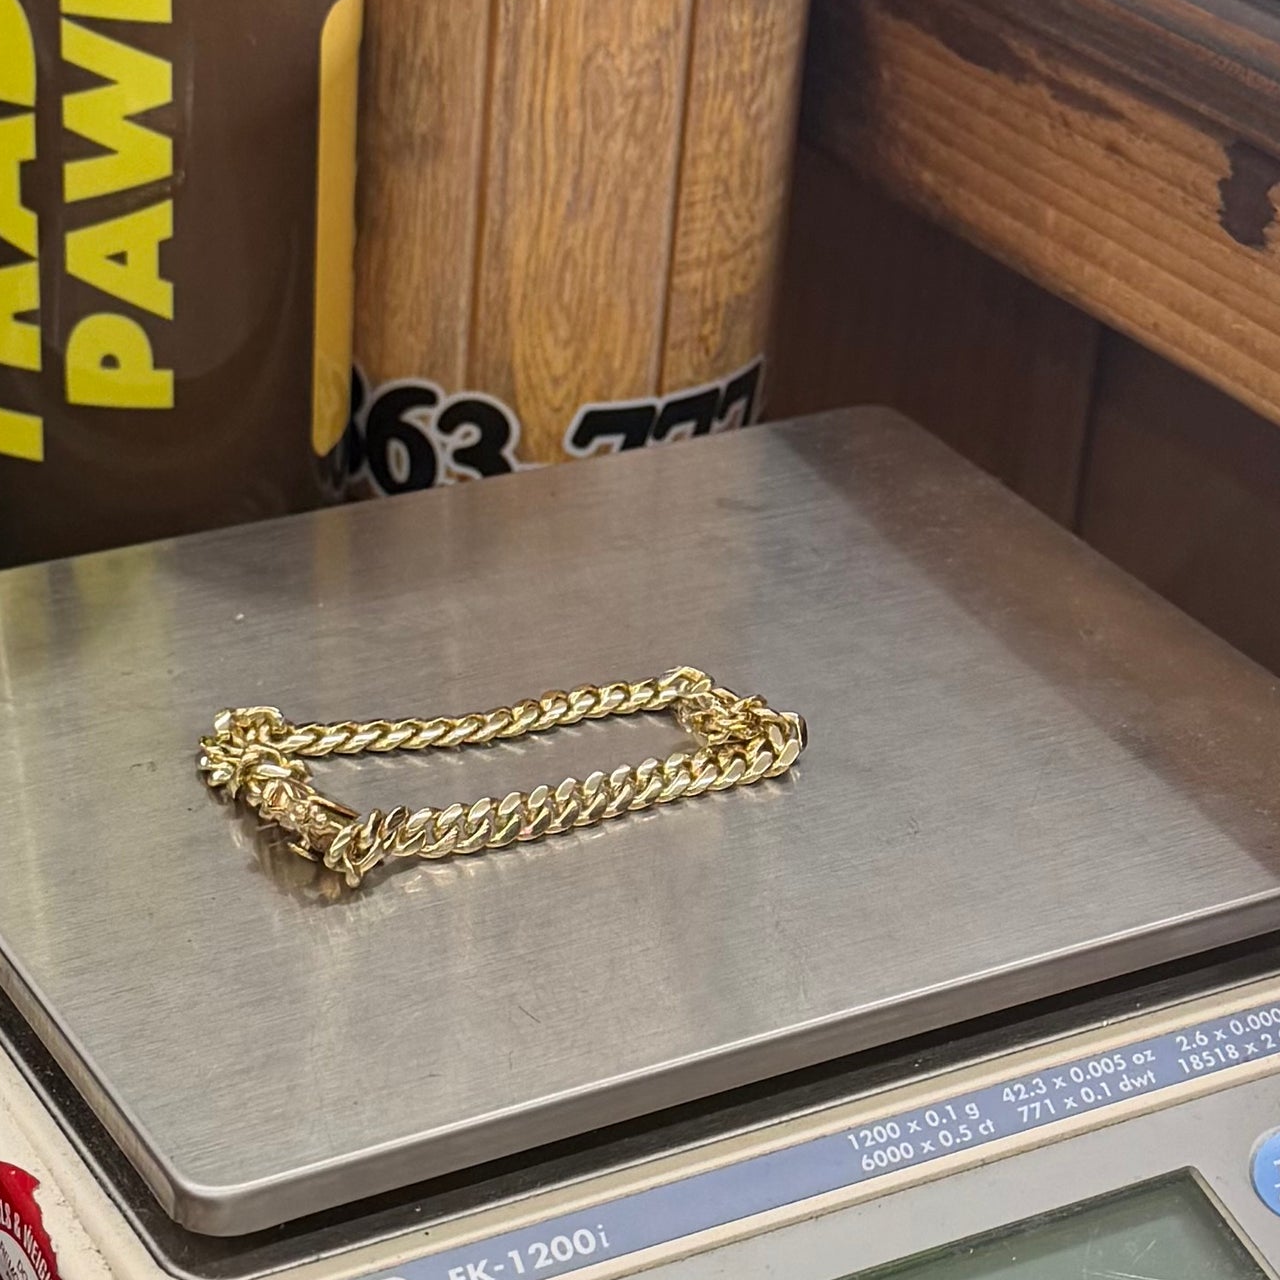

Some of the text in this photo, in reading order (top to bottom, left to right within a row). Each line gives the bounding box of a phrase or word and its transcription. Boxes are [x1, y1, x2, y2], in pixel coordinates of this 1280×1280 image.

[1175, 1029, 1211, 1053] 2.6
[1215, 1028, 1228, 1042] x
[1177, 1042, 1241, 1075] 18518
[1245, 1041, 1258, 1056] x
[1260, 1033, 1277, 1051] 2
[1002, 1049, 1157, 1105] 42.3 x 0.005 oz
[1017, 1068, 1158, 1124] 771 x 0.1 dwt
[847, 1102, 981, 1151] 1200 x 0.1 g
[861, 1119, 995, 1173] 6000 x 0.5 ct
